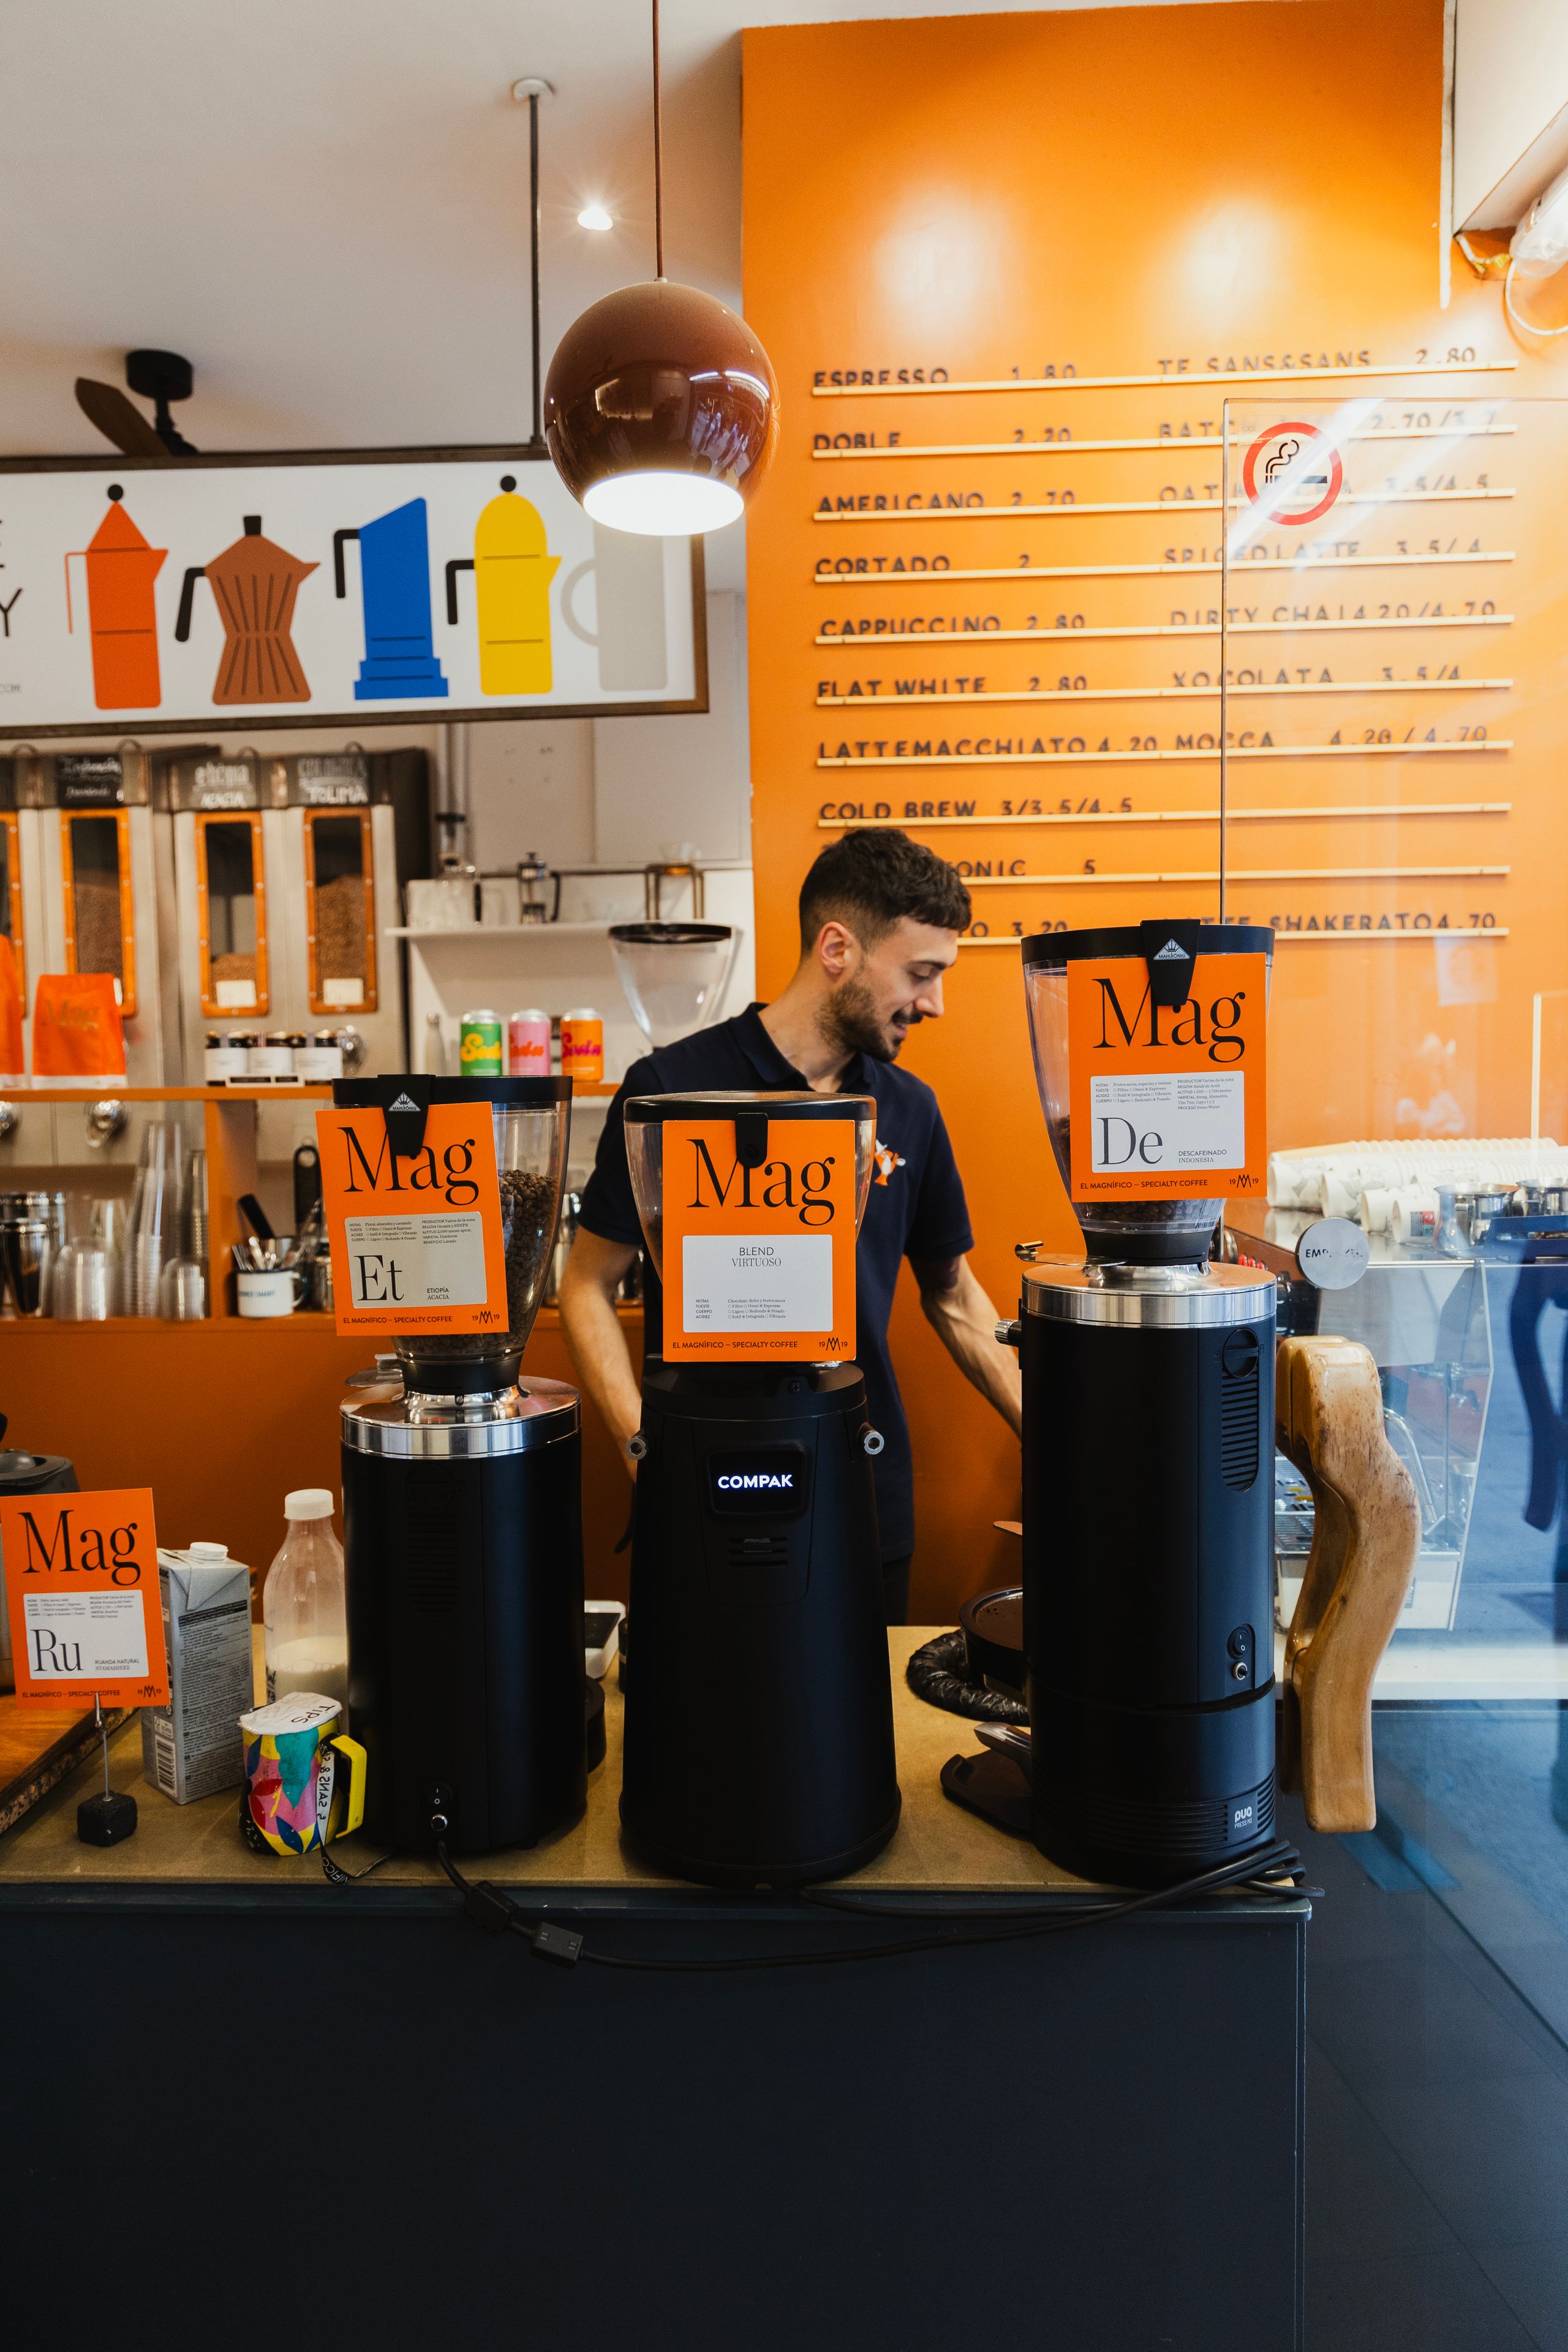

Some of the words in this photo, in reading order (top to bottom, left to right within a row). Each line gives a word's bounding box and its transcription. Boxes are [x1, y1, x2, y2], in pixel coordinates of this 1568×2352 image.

[1416, 347, 1476, 364] 2.80
[813, 368, 948, 387] ESPRESSO
[1012, 364, 1076, 380] 1.80
[814, 432, 900, 450] DOBLE
[1015, 428, 1071, 443] 2.20
[819, 492, 985, 511] AMERICANO
[1012, 491, 1074, 507] 2.70
[816, 556, 949, 575] CORTADO
[1020, 554, 1030, 568] 2
[821, 616, 1000, 636] CAPPUCCINO
[1027, 615, 1084, 630] 2.80
[1171, 608, 1259, 626] DIRTY
[818, 680, 882, 697] FLAT
[895, 677, 986, 695] WHITE
[1029, 676, 1087, 691] 2.80
[1172, 669, 1334, 688] XOCOLATA
[1099, 736, 1156, 752] 4.20
[1176, 732, 1274, 750] MOCCA
[820, 802, 891, 820] COLD
[905, 800, 976, 817] BREW
[948, 861, 1026, 876] ONIC
[1085, 860, 1096, 874] 5
[1271, 913, 1432, 930] SHAKERATO
[1092, 978, 1245, 1063] Mag
[1096, 1117, 1163, 1165] De
[337, 1126, 479, 1205] Mag
[686, 1139, 835, 1226] Mag
[740, 1247, 774, 1256] BLEND
[732, 1257, 782, 1267] VIRTUOSO
[354, 1255, 404, 1301] Et
[718, 1474, 793, 1488] COMPAK
[18, 1510, 141, 1586] Mag
[31, 1629, 85, 1672] Ru
[292, 1705, 335, 1723] TIPS
